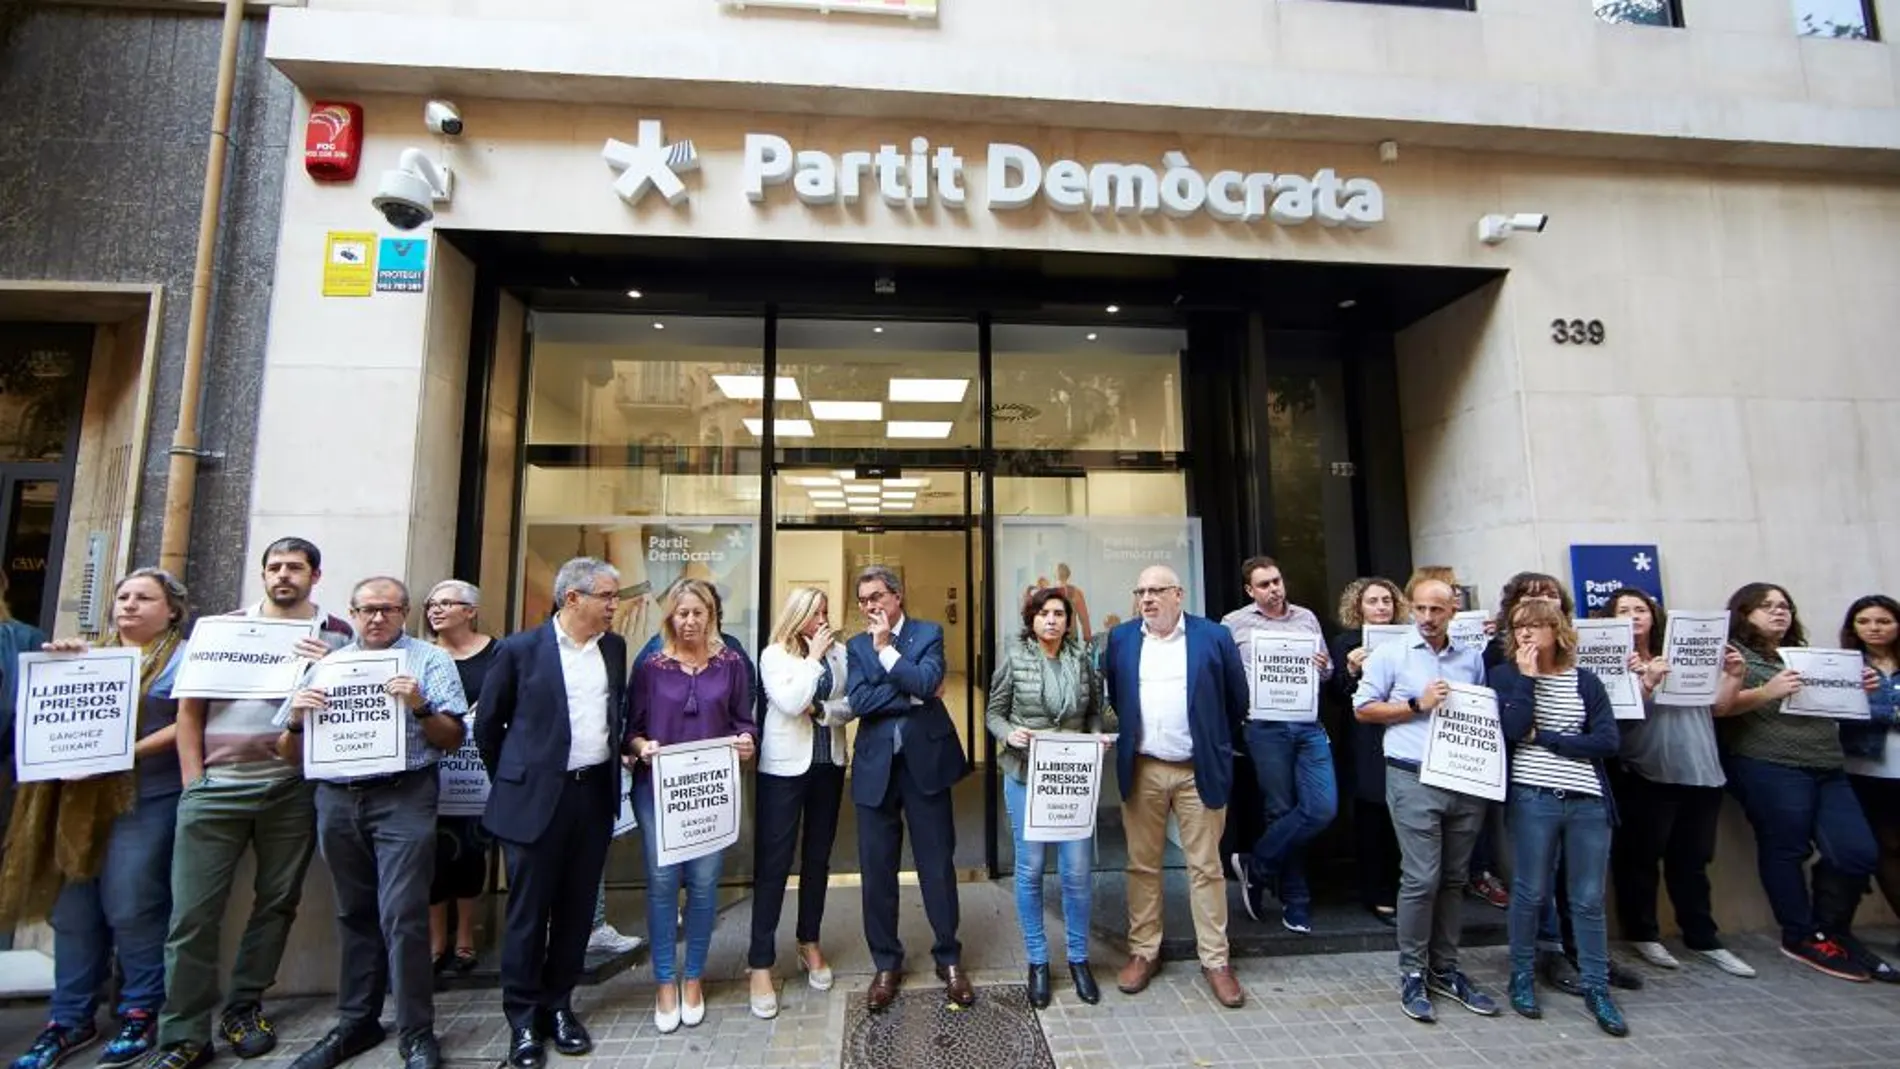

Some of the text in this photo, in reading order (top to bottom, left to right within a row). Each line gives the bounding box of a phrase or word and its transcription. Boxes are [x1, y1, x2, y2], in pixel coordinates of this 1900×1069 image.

[744, 133, 1384, 225] Partit Demòcrata
[1550, 318, 1604, 345] 339
[648, 535, 691, 549] Partit
[648, 548, 725, 562] Demòcrata
[1258, 654, 1311, 666] LLIBERTAT
[1579, 655, 1622, 664] PRESOS
[1263, 665, 1306, 675] PRESOS
[32, 681, 127, 698] LLIBERTAT
[40, 694, 117, 710] PRESOS
[1438, 708, 1500, 728] LLIBERTAT
[1442, 720, 1496, 740] PRESOS
[1036, 761, 1093, 773] LLIBERTAT
[663, 768, 730, 788] LLIBERTAT
[1040, 774, 1088, 784] PRESOS
[670, 782, 725, 801] PRESOS
